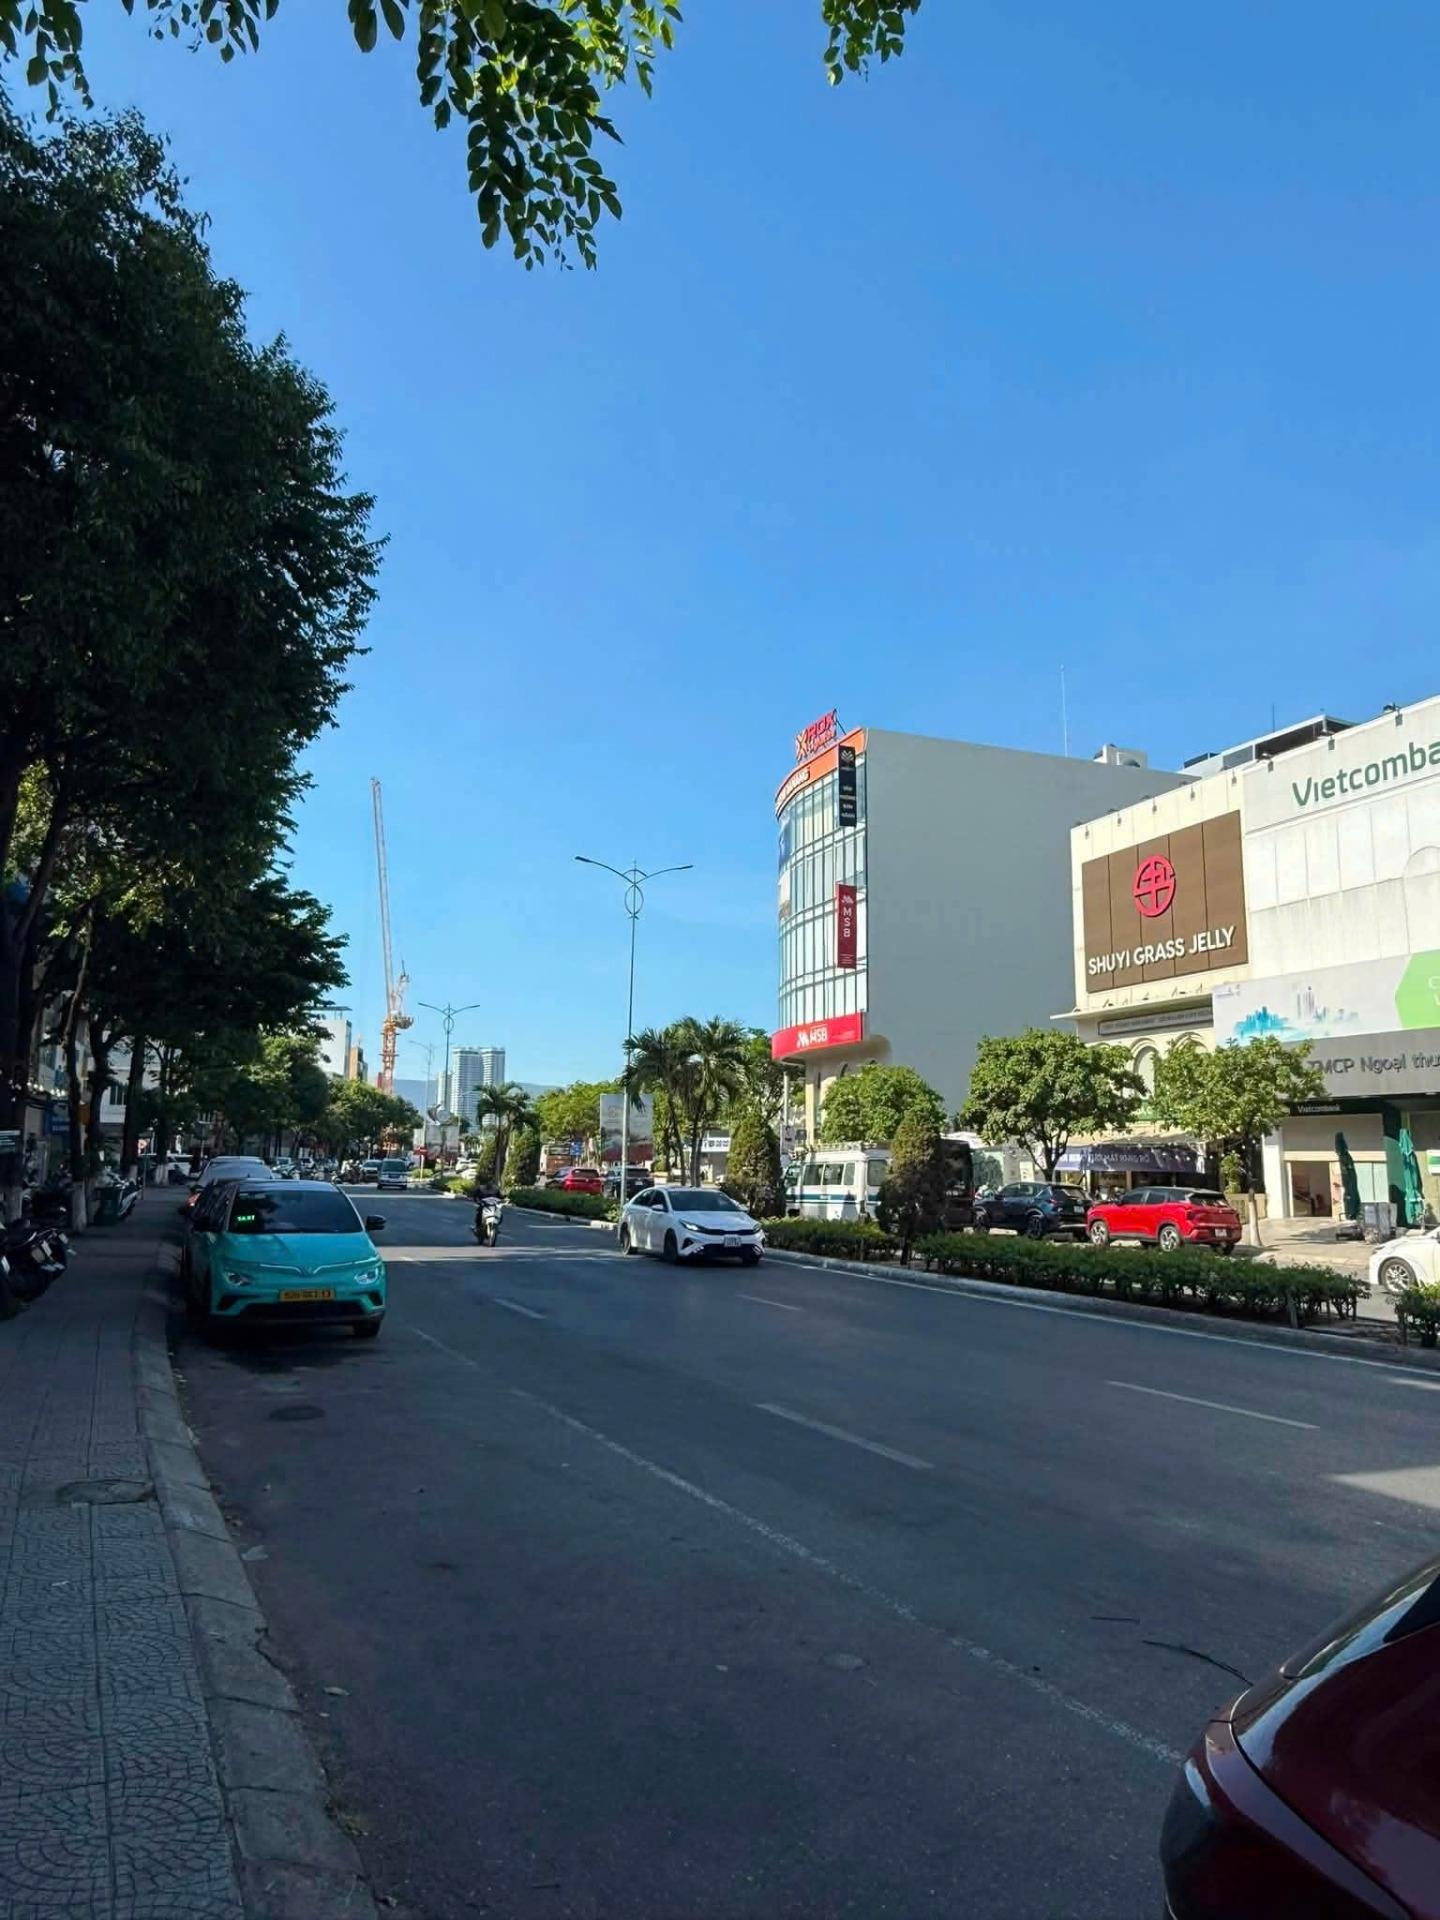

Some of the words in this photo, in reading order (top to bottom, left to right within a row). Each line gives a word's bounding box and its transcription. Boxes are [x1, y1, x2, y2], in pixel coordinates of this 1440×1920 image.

[843, 906, 852, 938] MSB
[1088, 950, 1130, 975] SHUYI
[1133, 938, 1184, 965] GRASS
[1189, 925, 1235, 954] JELLY
